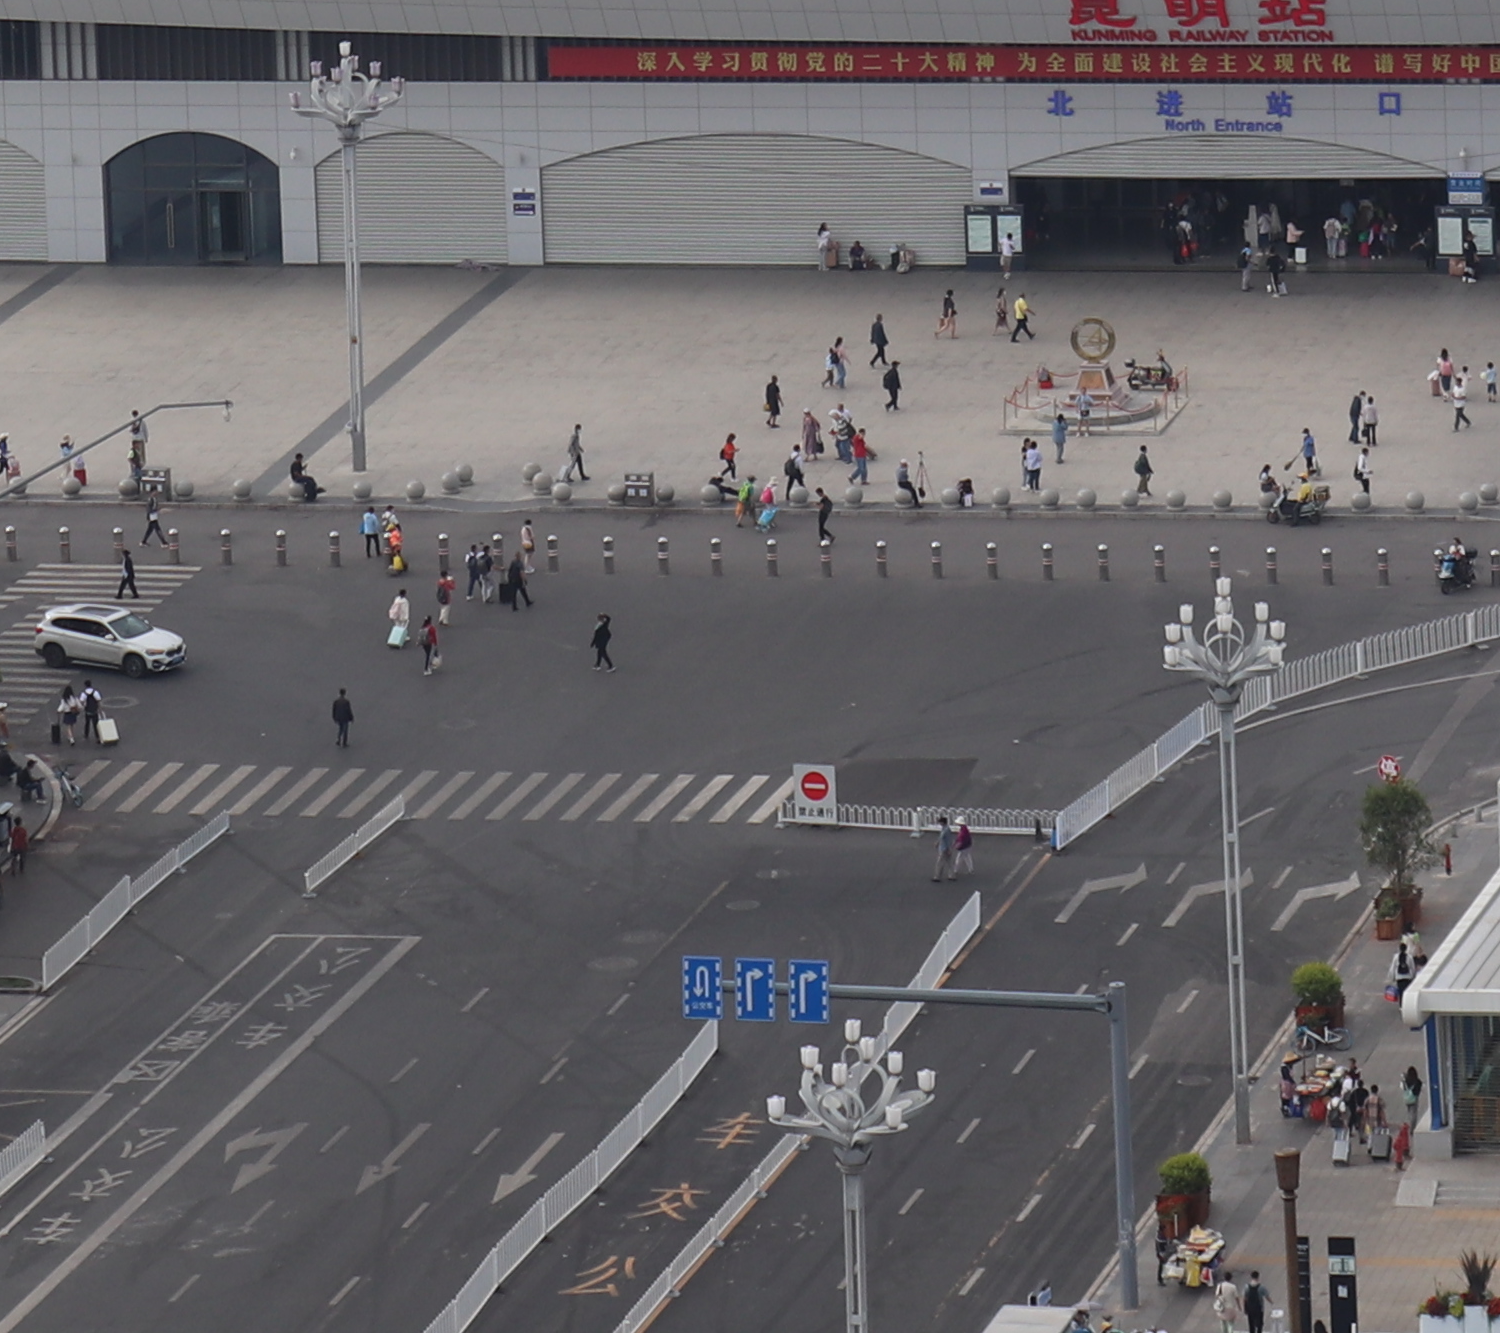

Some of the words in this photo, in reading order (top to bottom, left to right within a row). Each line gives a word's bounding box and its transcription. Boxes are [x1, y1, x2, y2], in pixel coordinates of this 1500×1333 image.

[1070, 29, 1158, 43] KUNMING
[1169, 29, 1249, 43] RAILWAY
[1257, 29, 1334, 43] STATION
[637, 51, 997, 74] 深入学习贯彻党的二十大精神
[1017, 52, 1353, 74] 为全面建设社会主义现代化
[1046, 90, 1403, 118] 北进站口
[1165, 118, 1206, 132] North
[1214, 119, 1283, 132] Entrance
[799, 806, 834, 819] 禁止通行
